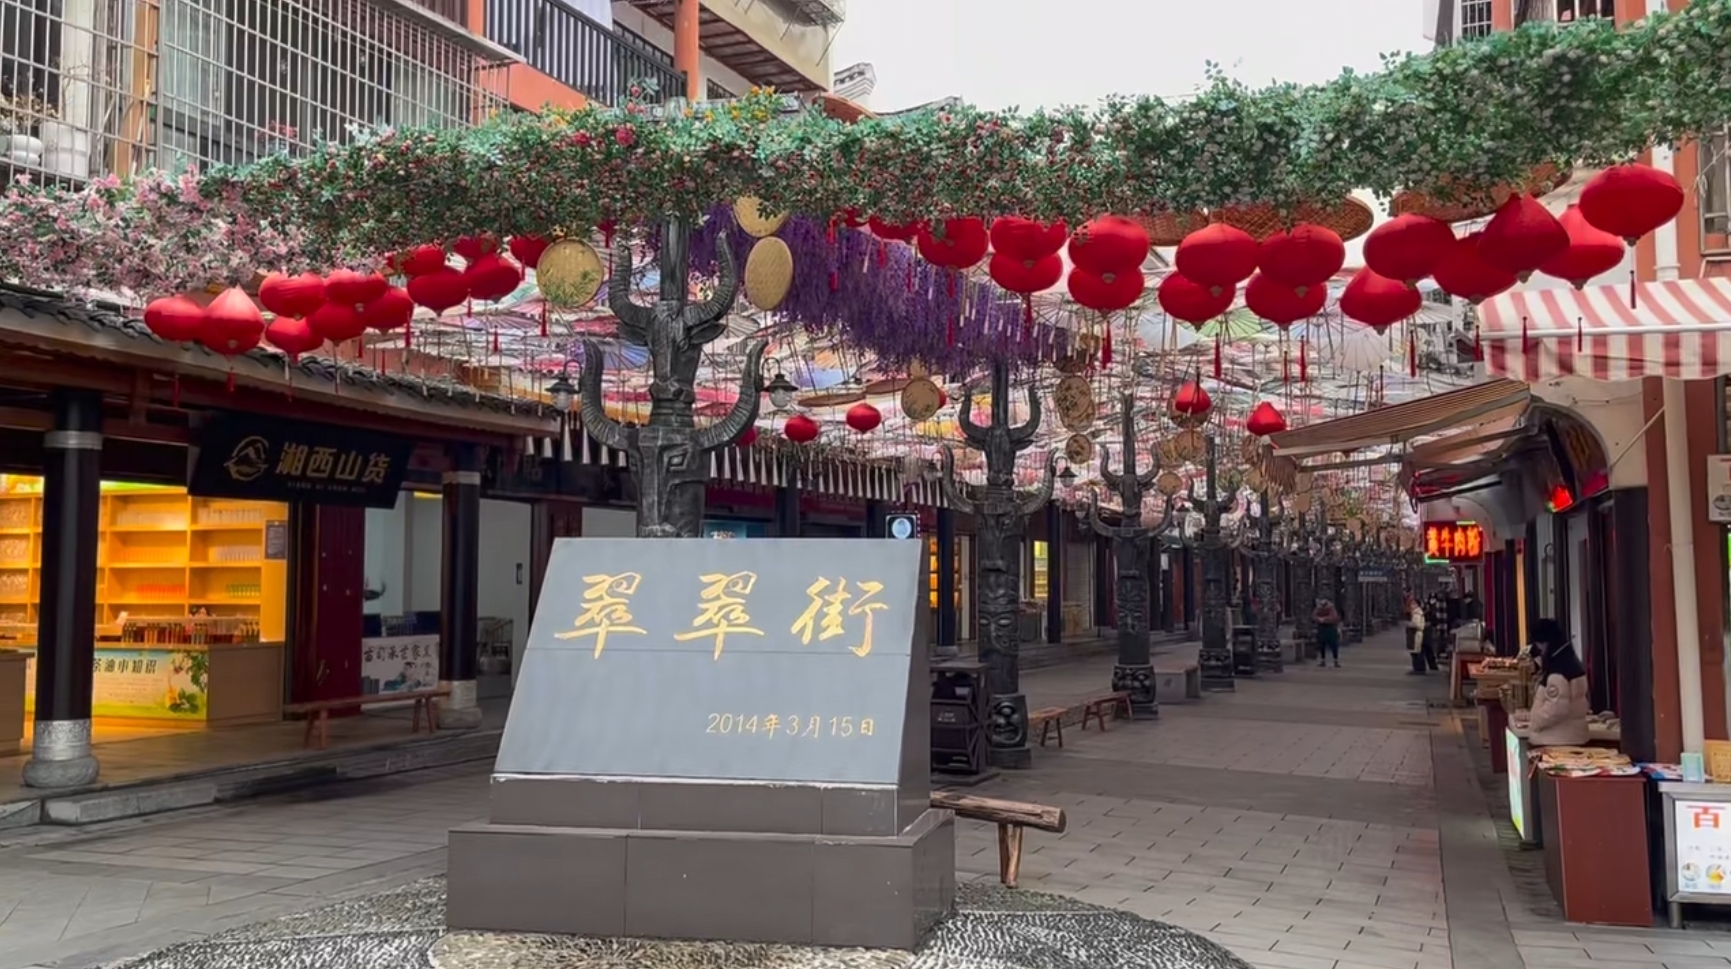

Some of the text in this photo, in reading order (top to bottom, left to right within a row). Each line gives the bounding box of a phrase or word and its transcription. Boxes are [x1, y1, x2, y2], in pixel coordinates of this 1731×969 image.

[275, 441, 391, 483] 湘西山货
[1427, 526, 1480, 557] 黄牛肉粉
[554, 571, 889, 661] 翠翠街
[706, 712, 875, 739] 2014年3月15日
